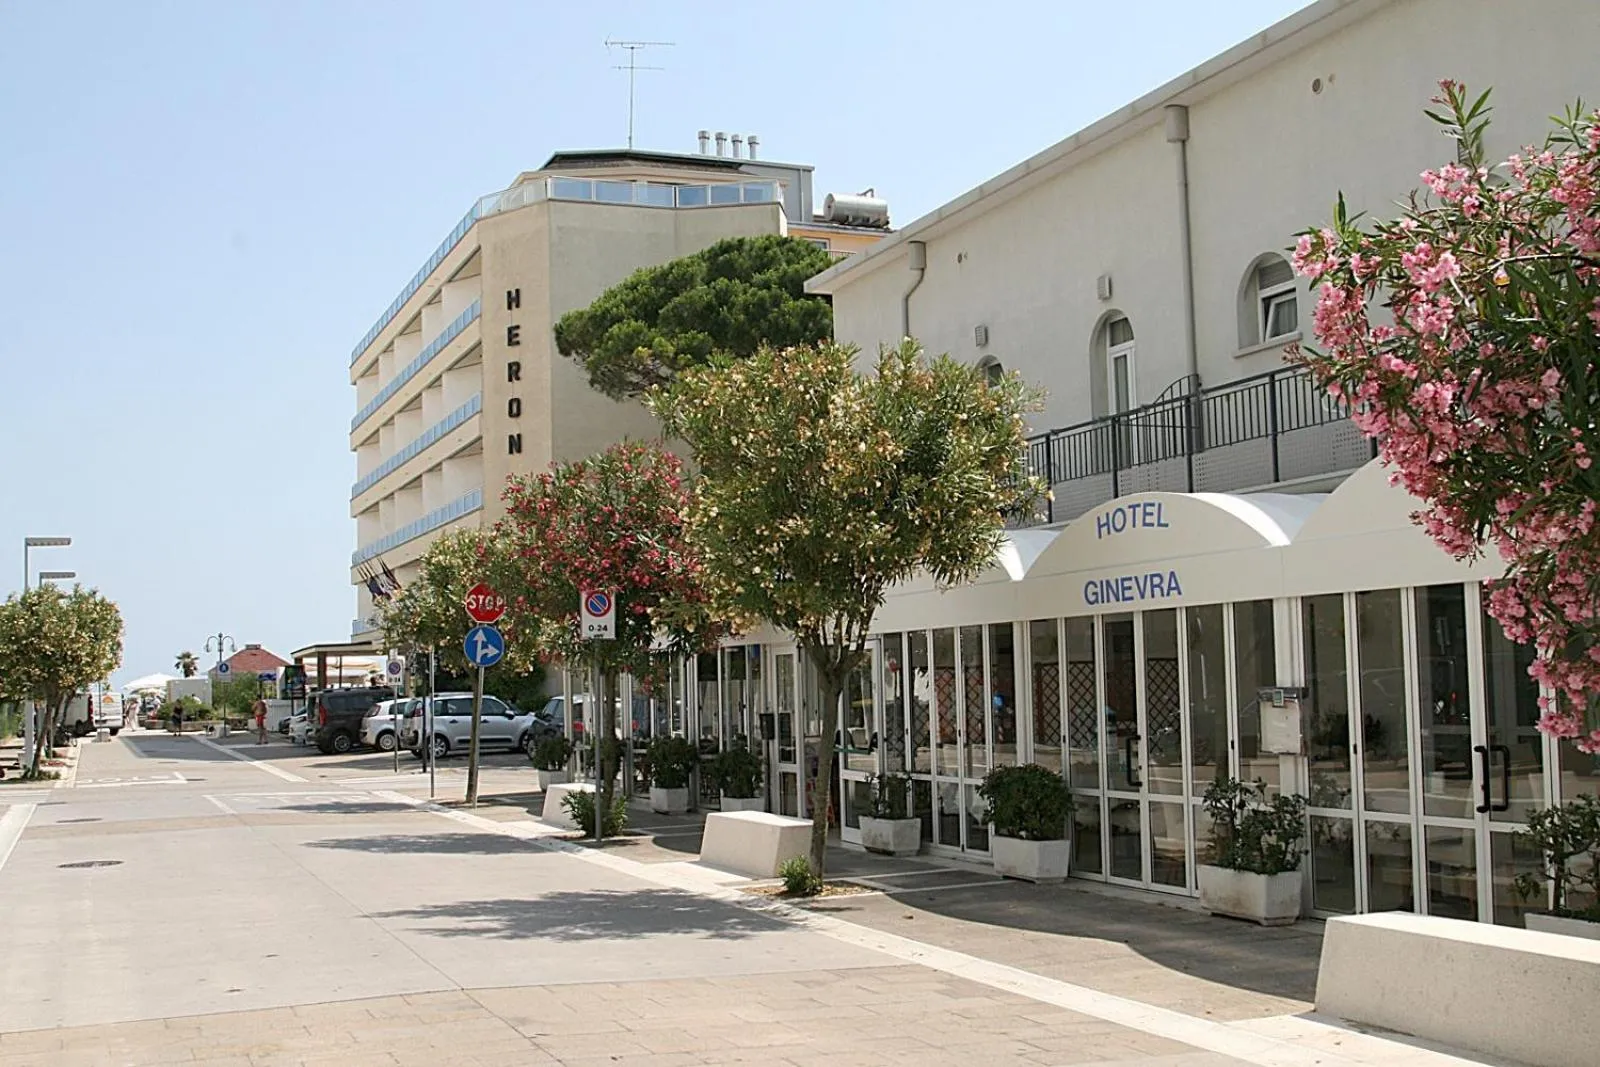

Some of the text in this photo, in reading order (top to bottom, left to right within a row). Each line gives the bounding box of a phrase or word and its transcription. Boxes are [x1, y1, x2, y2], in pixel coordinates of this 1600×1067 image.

[506, 288, 523, 455] HERON
[1096, 502, 1169, 539] HOTEL
[468, 594, 504, 612] STOP
[1084, 570, 1182, 605] GINEVRA
